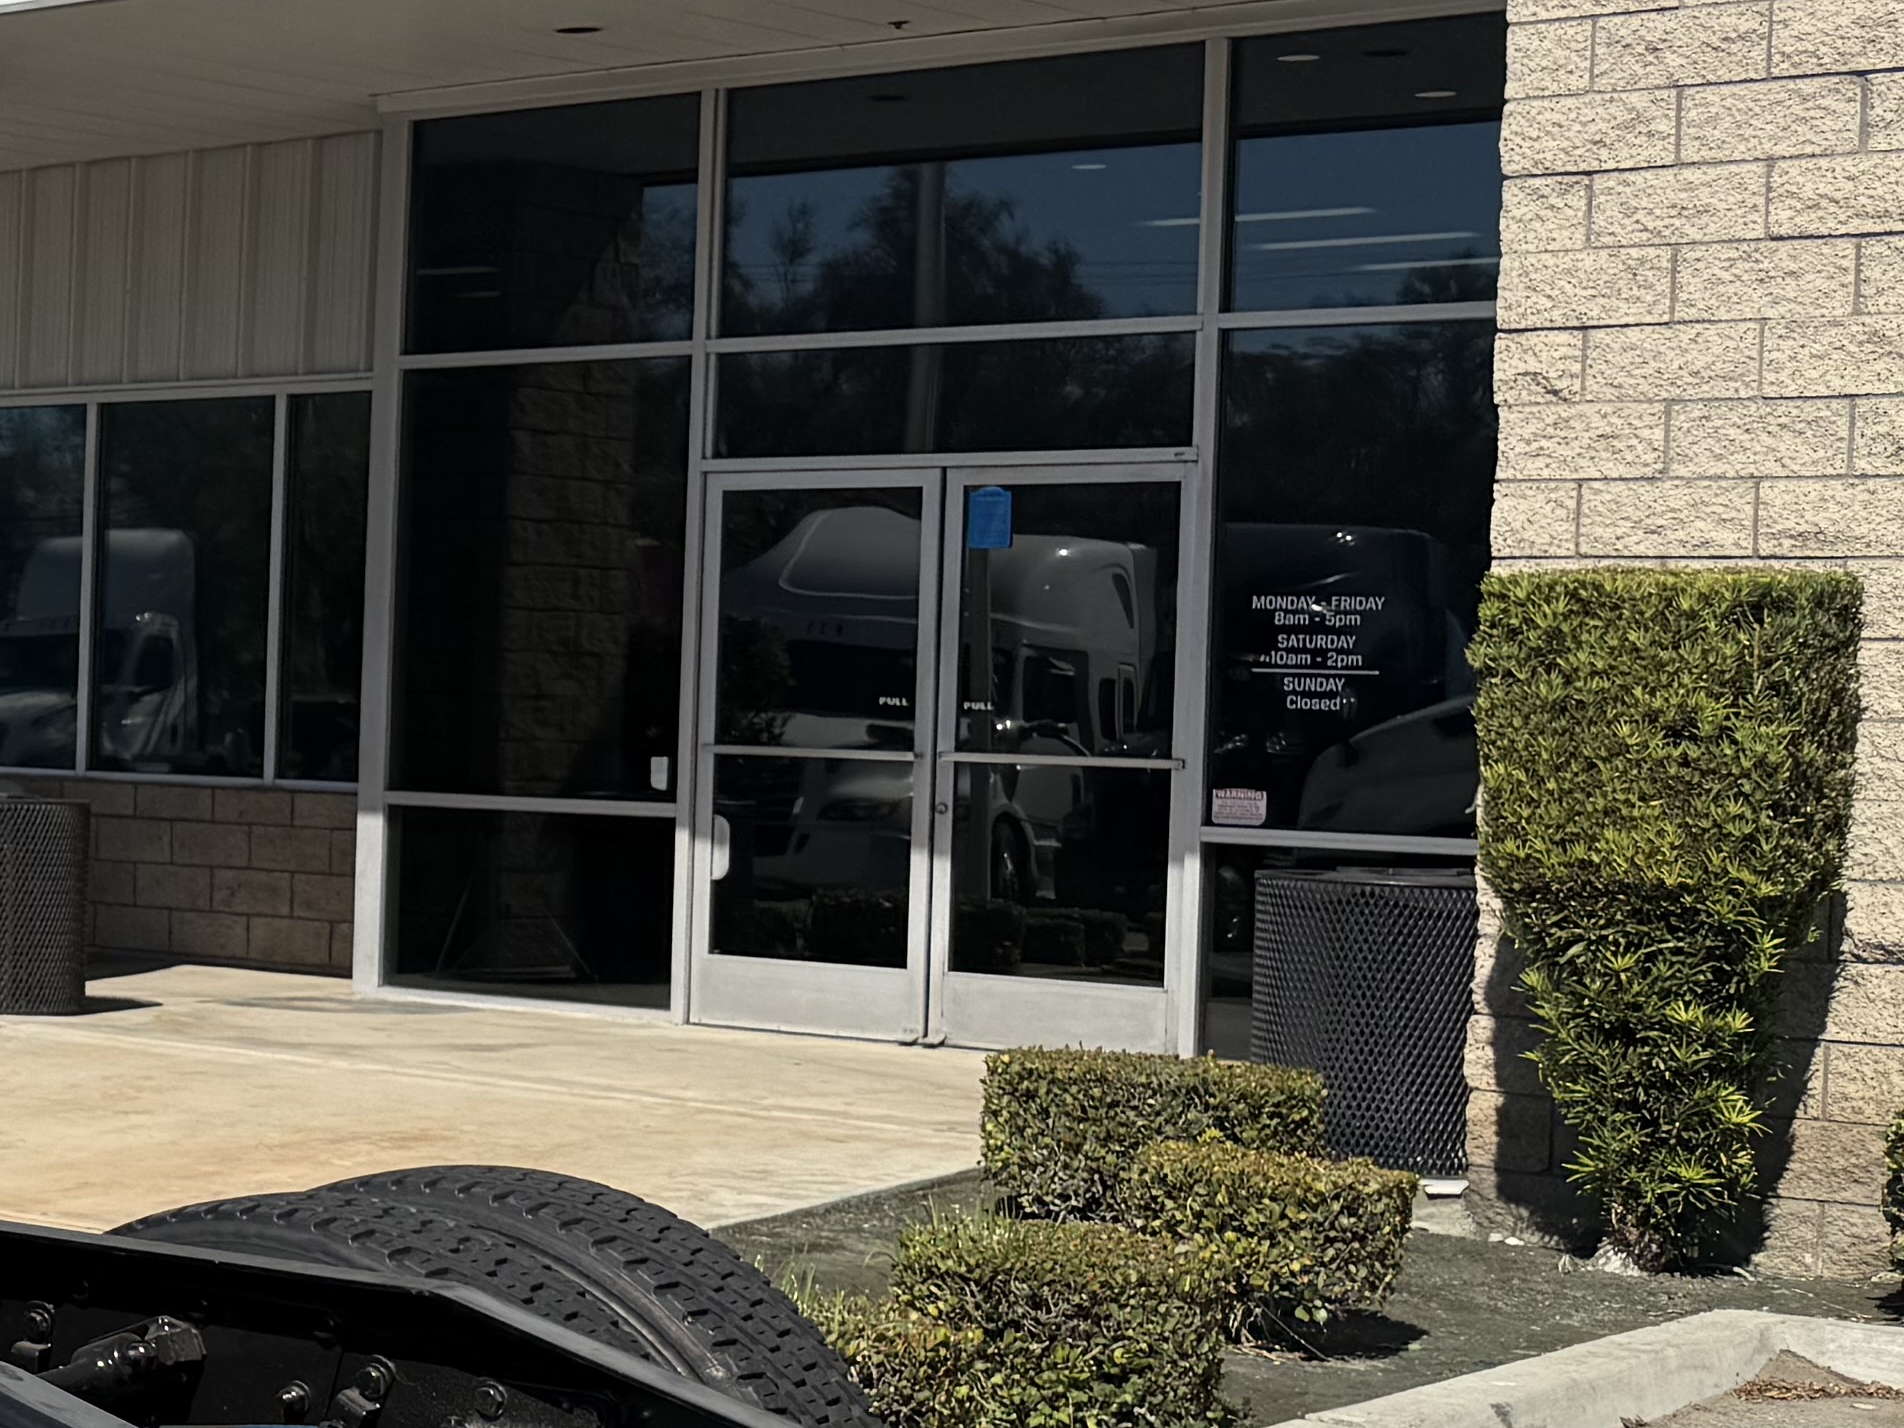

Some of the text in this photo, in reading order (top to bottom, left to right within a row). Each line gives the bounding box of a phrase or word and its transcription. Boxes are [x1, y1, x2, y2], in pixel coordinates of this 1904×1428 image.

[1252, 595, 1315, 610] MONDAY
[1331, 596, 1385, 610] FRIDAY
[1274, 612, 1309, 625] 8am
[1325, 612, 1361, 628] 5pm
[1277, 634, 1356, 649] SATURDAY
[1270, 650, 1311, 666] 10am
[1327, 652, 1362, 668] 2pm
[1283, 677, 1345, 692] SUNDAY
[878, 696, 908, 706] PULL
[963, 701, 993, 711] PULL
[1286, 695, 1340, 710] Closed
